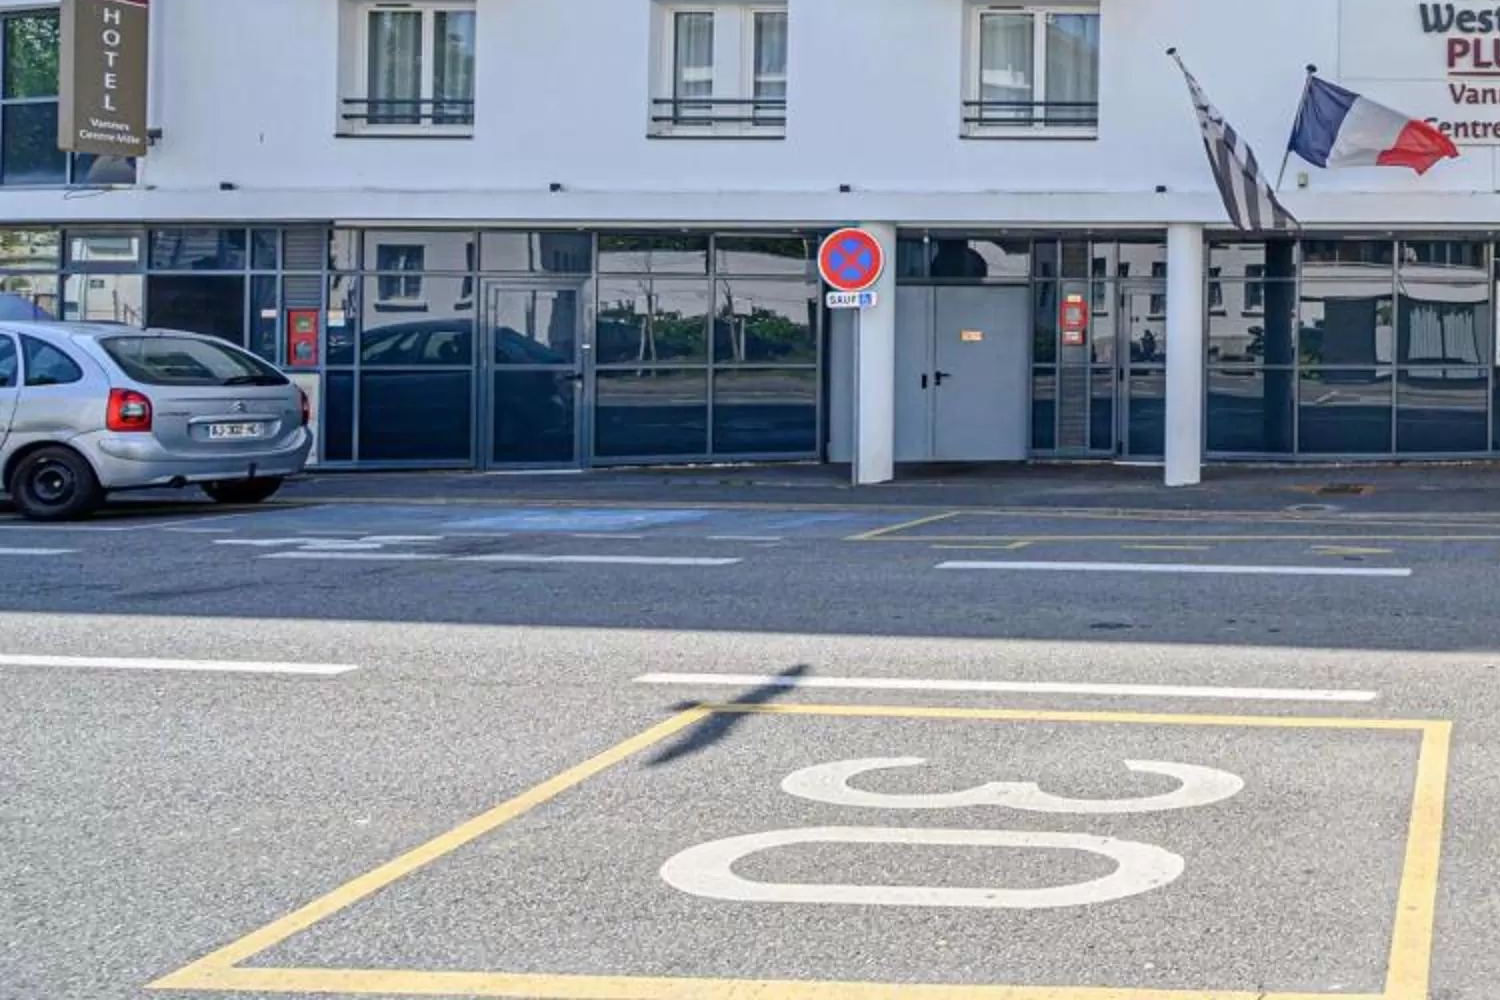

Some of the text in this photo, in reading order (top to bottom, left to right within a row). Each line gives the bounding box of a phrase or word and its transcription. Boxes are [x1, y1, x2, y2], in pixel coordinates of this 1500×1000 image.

[102, 7, 121, 112] HOTEL
[829, 295, 856, 305] SAUF
[659, 757, 1244, 909] 30
